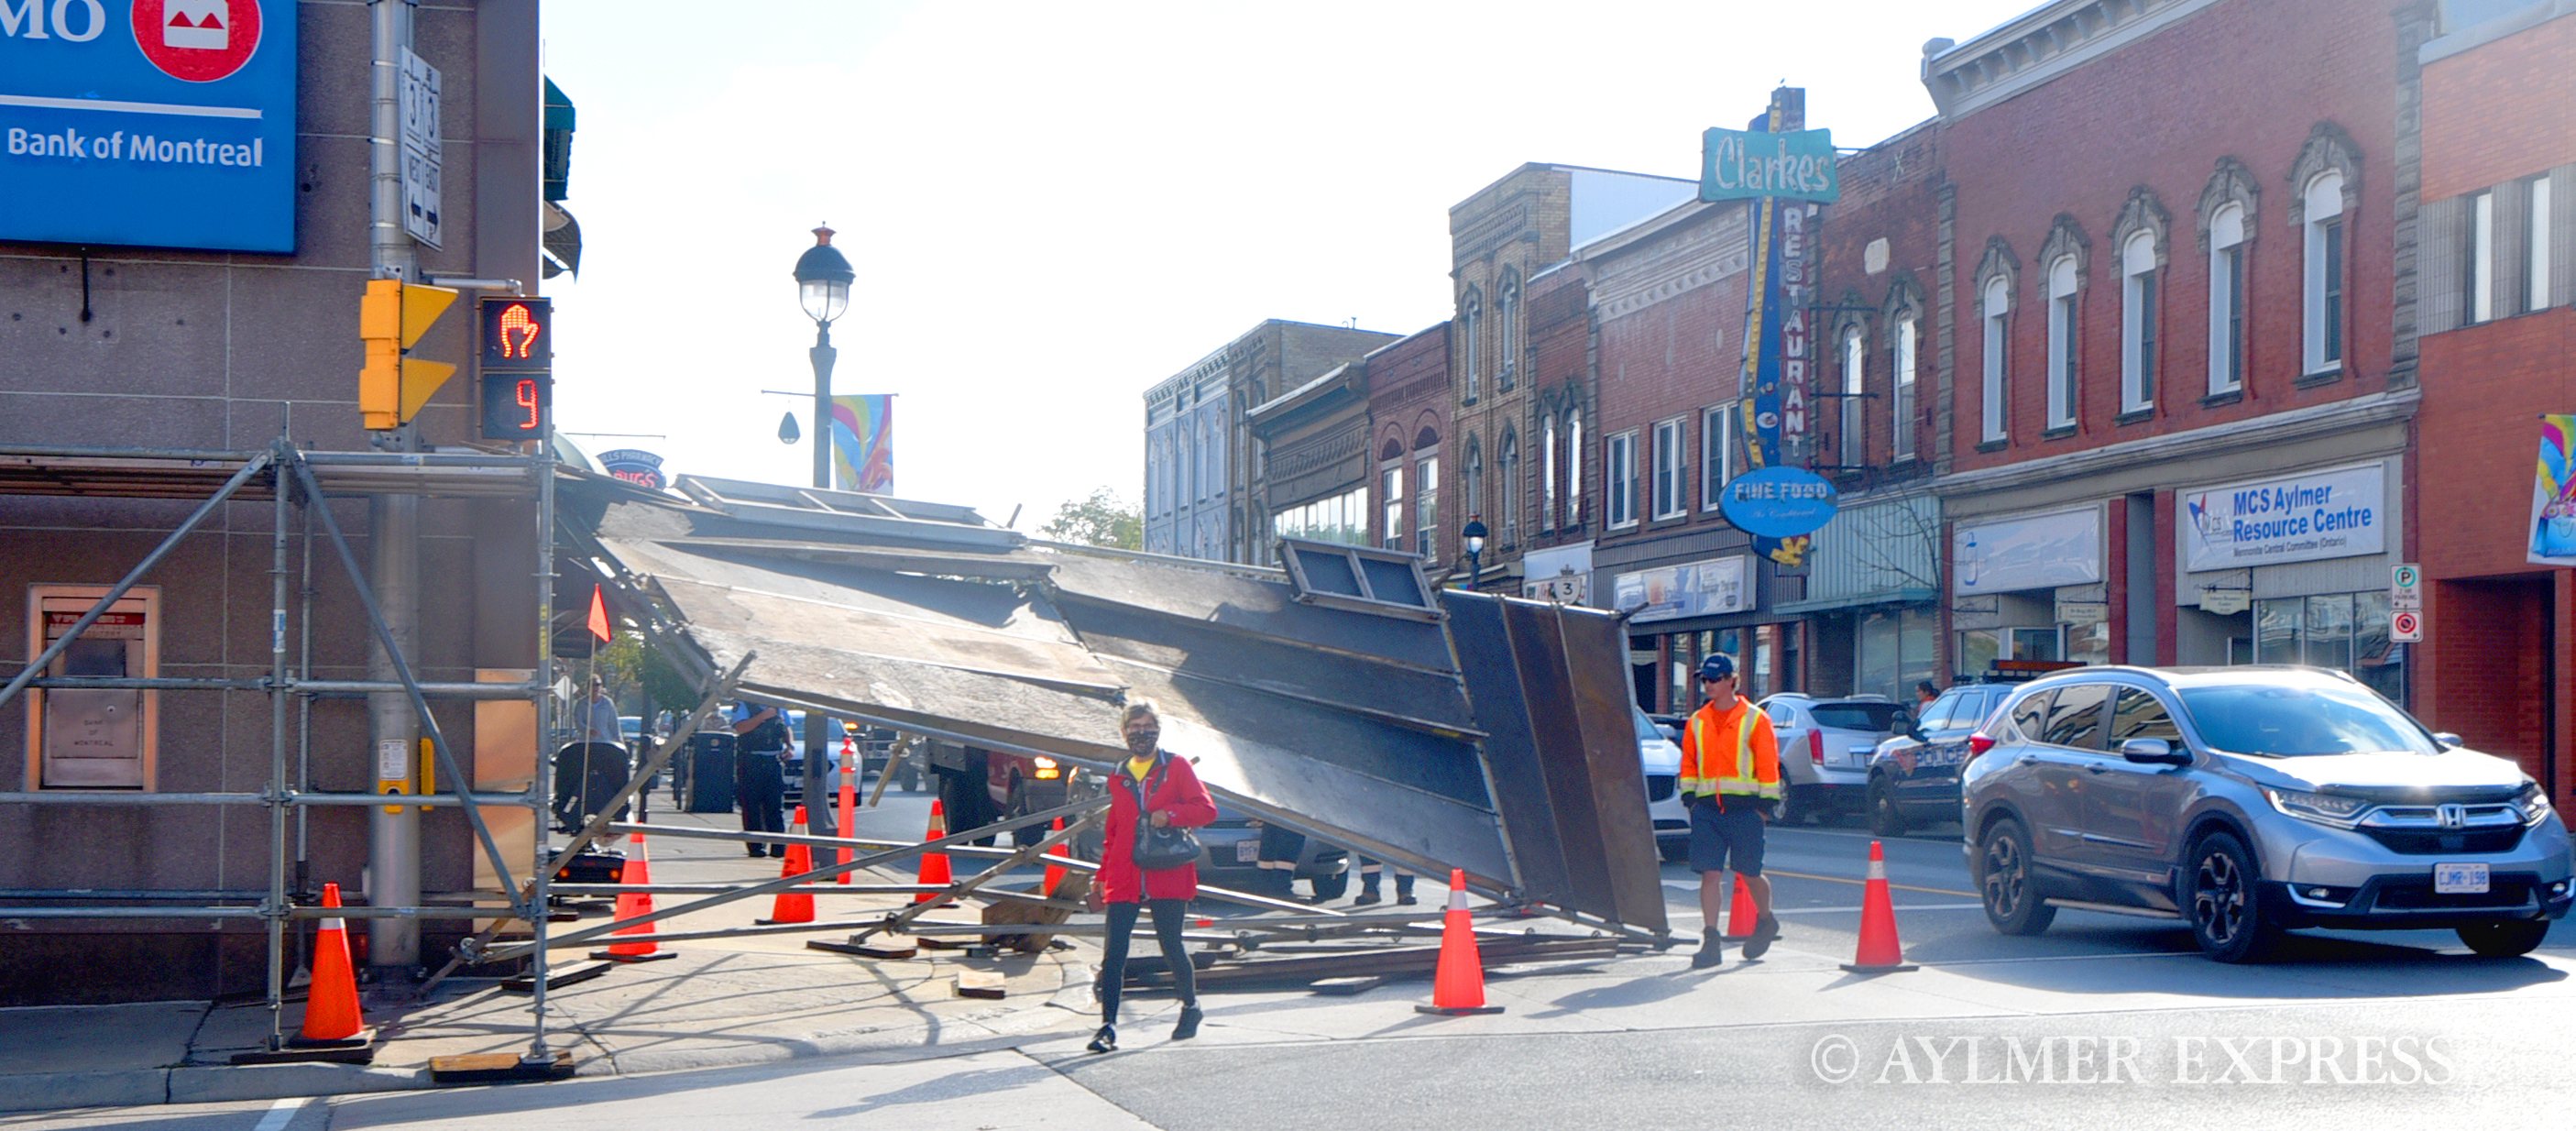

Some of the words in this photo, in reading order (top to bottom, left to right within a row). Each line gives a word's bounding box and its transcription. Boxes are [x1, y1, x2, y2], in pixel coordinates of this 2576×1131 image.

[410, 82, 416, 126] 3
[428, 95, 435, 138] 3
[7, 127, 88, 159] Bank
[93, 131, 124, 159] of
[128, 135, 264, 168] Montreal
[409, 154, 421, 183] WEST
[425, 163, 438, 194] EAST
[1715, 136, 1831, 192] Clarkes
[1782, 206, 1805, 458] RESTAURANT
[516, 379, 539, 429] 9
[1735, 481, 1775, 500] FINE
[1780, 481, 1828, 501] FOOD
[2233, 487, 2271, 516] MCS
[2274, 484, 2332, 515] Aylmer
[2233, 515, 2308, 543] Resource
[2313, 504, 2373, 533] Centre
[2264, 542, 2285, 555] Central
[2286, 539, 2318, 552] Committee
[2319, 535, 2347, 550] (Ontario)
[1562, 582, 1573, 596] 3
[2401, 571, 2411, 583] P
[1914, 748, 1968, 766] POLICE
